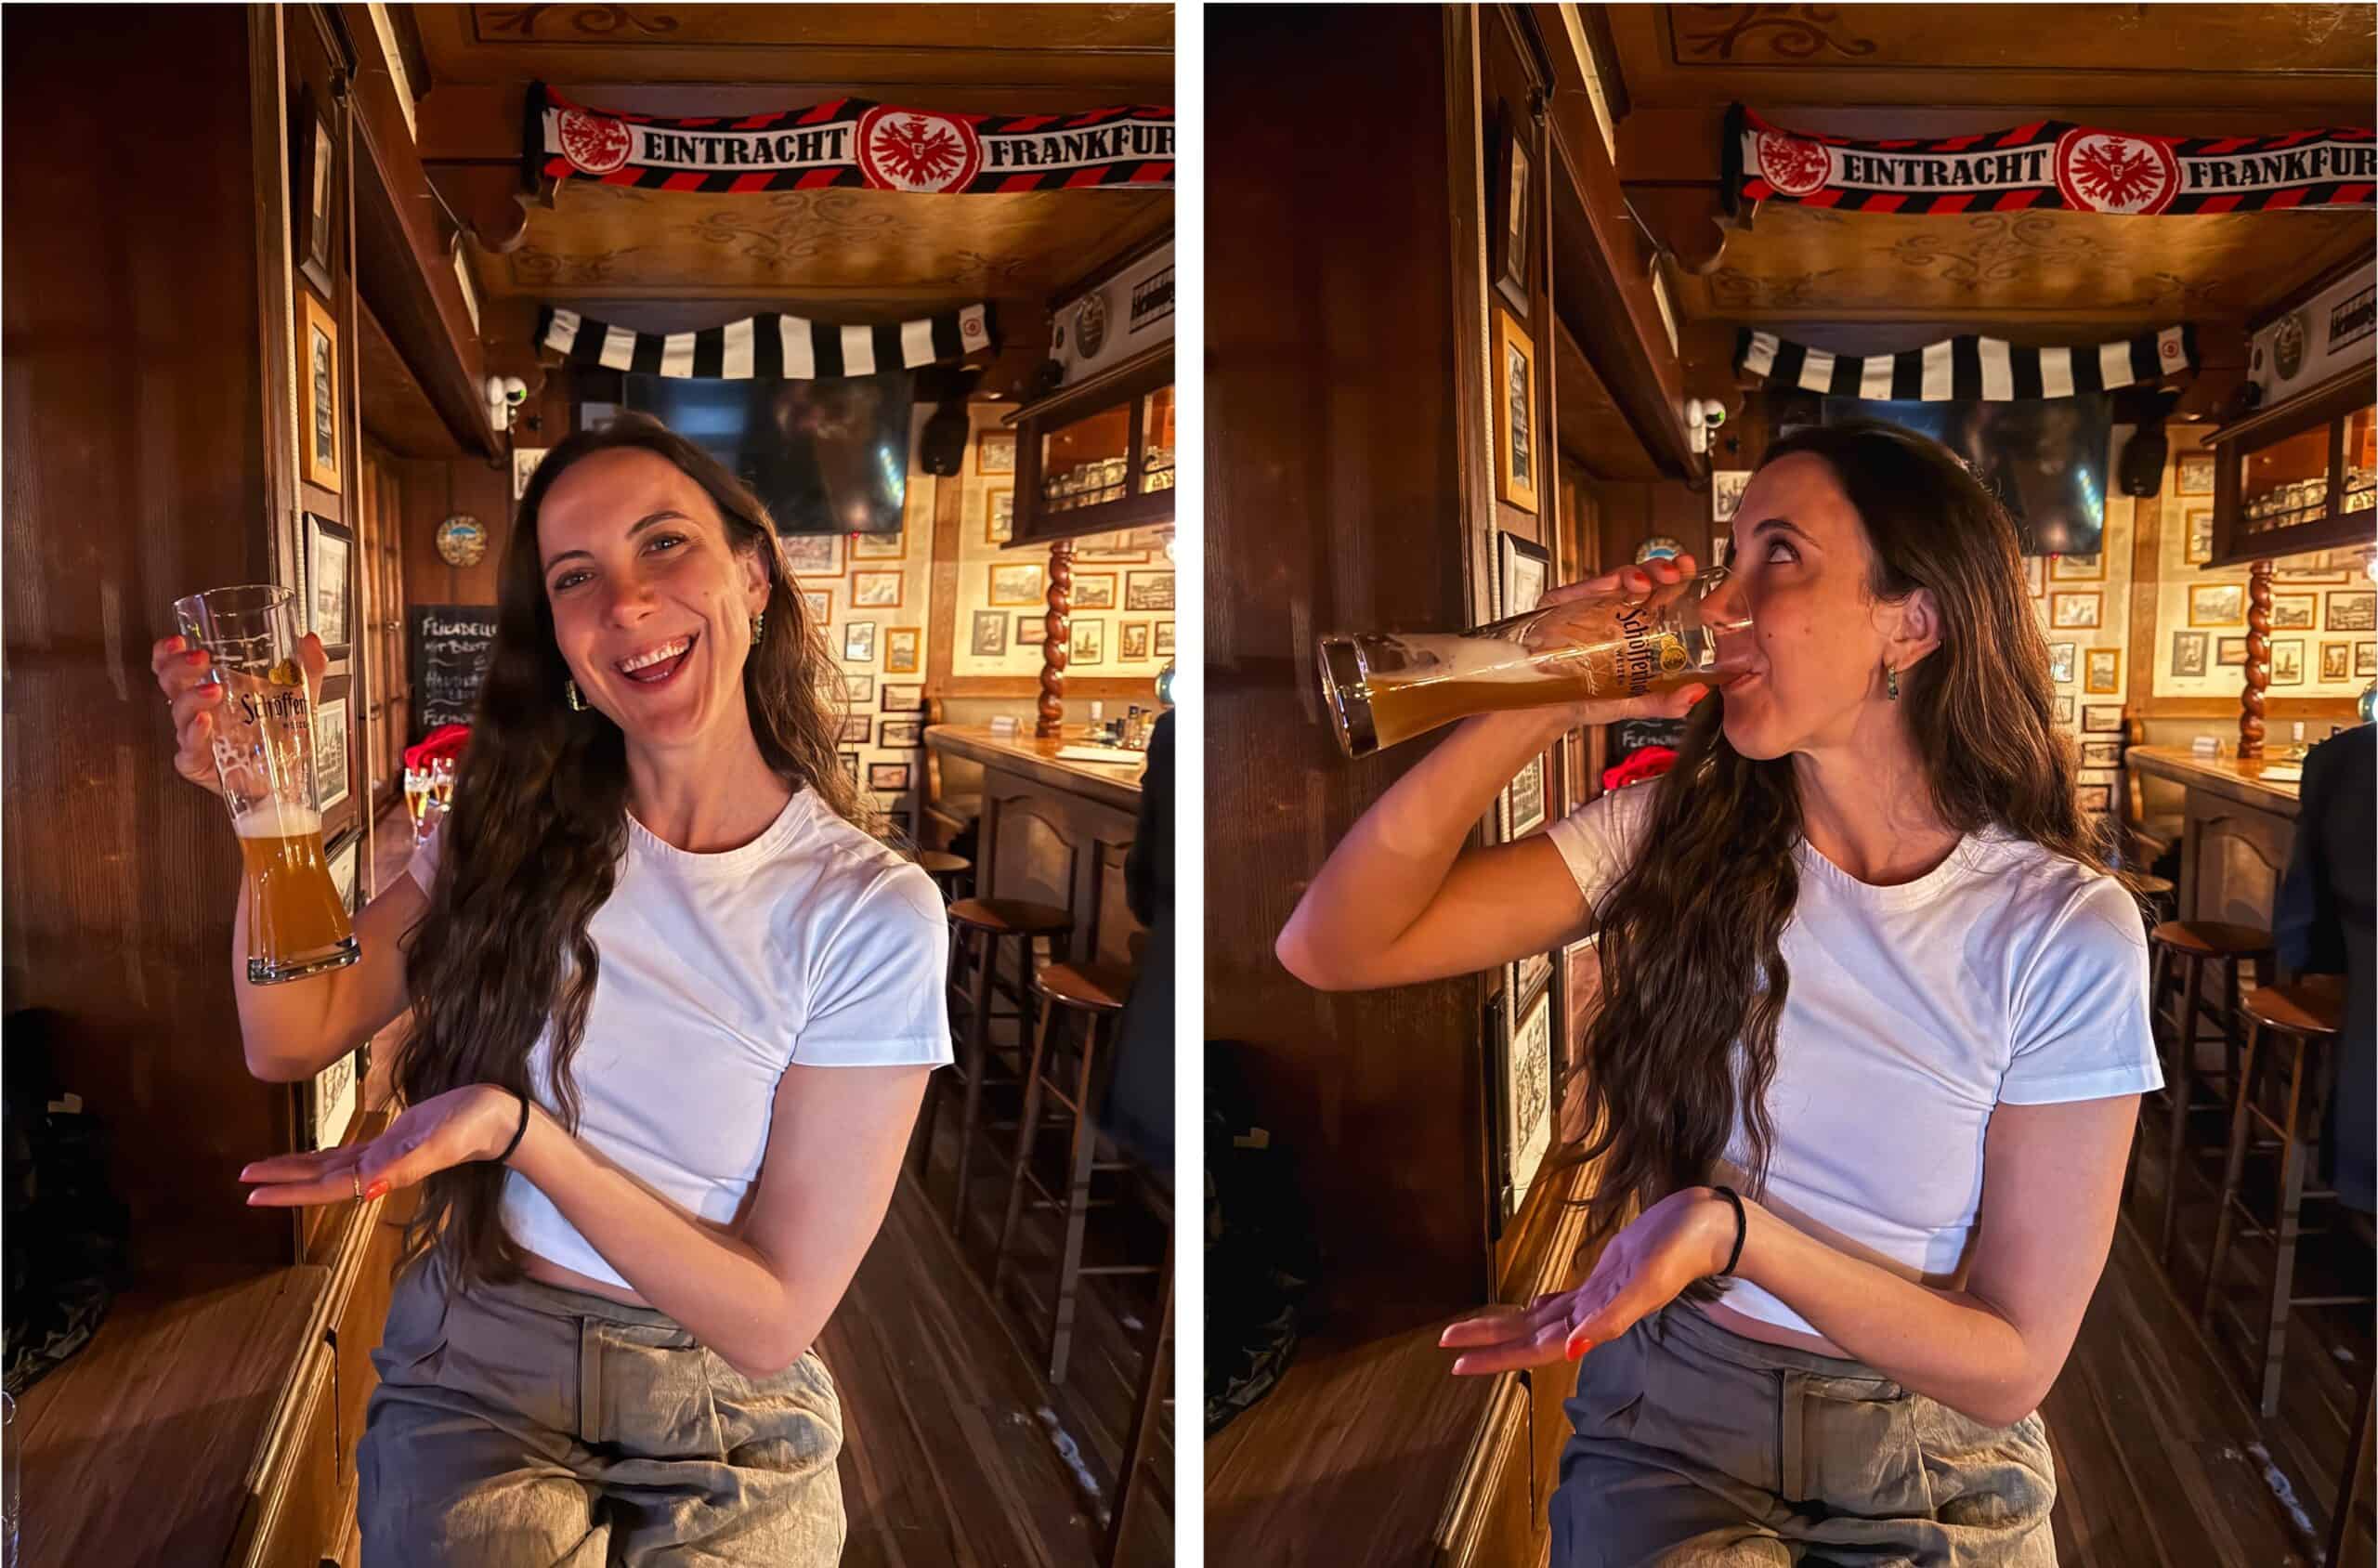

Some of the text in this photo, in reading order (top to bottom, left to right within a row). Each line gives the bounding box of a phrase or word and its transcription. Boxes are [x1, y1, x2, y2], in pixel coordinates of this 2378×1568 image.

[643, 124, 1174, 167] EINTRACHT FRANKFUR
[1842, 146, 2376, 188] EINTRACHT FRANKFUR
